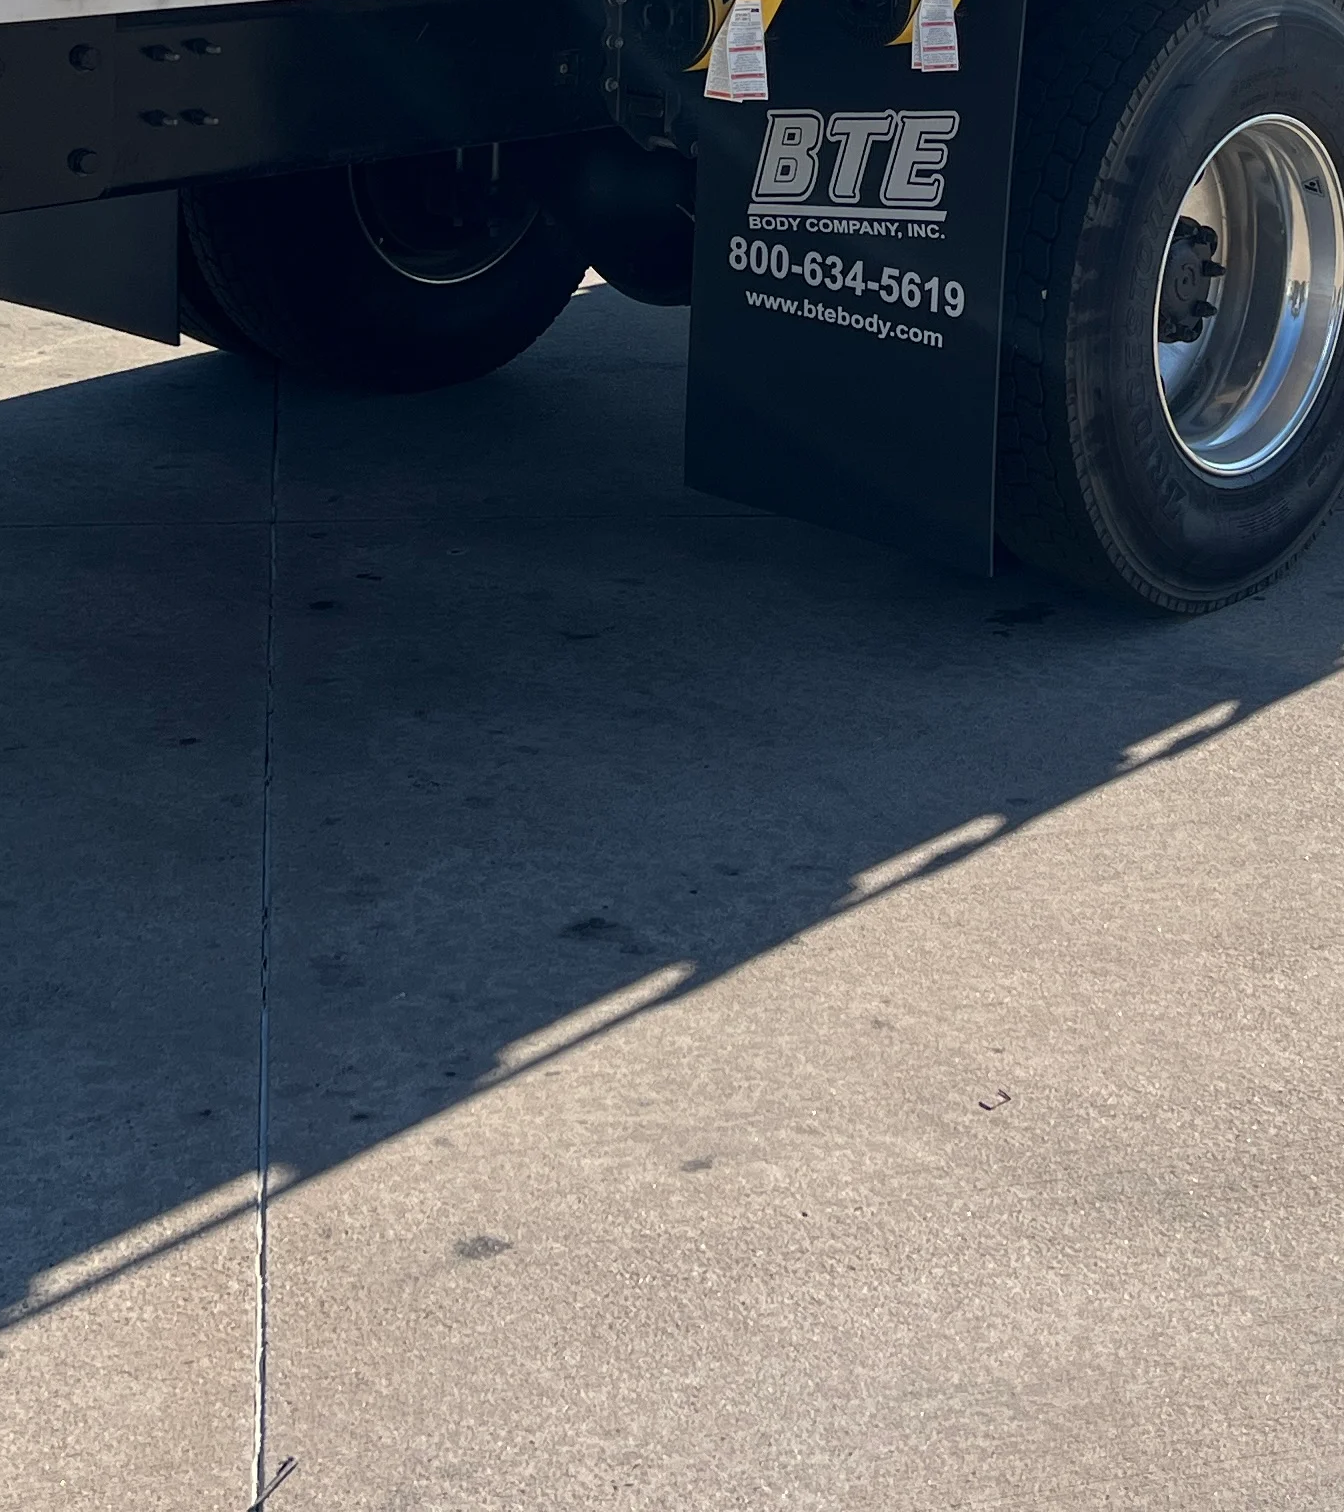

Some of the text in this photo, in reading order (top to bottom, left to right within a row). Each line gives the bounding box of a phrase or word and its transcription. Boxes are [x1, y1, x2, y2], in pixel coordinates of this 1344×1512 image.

[751, 108, 960, 208] BTE
[749, 216, 946, 240] BODY COMPANY, INC.
[728, 236, 966, 318] 800-634-5619
[745, 290, 944, 348] www.btebody.com
